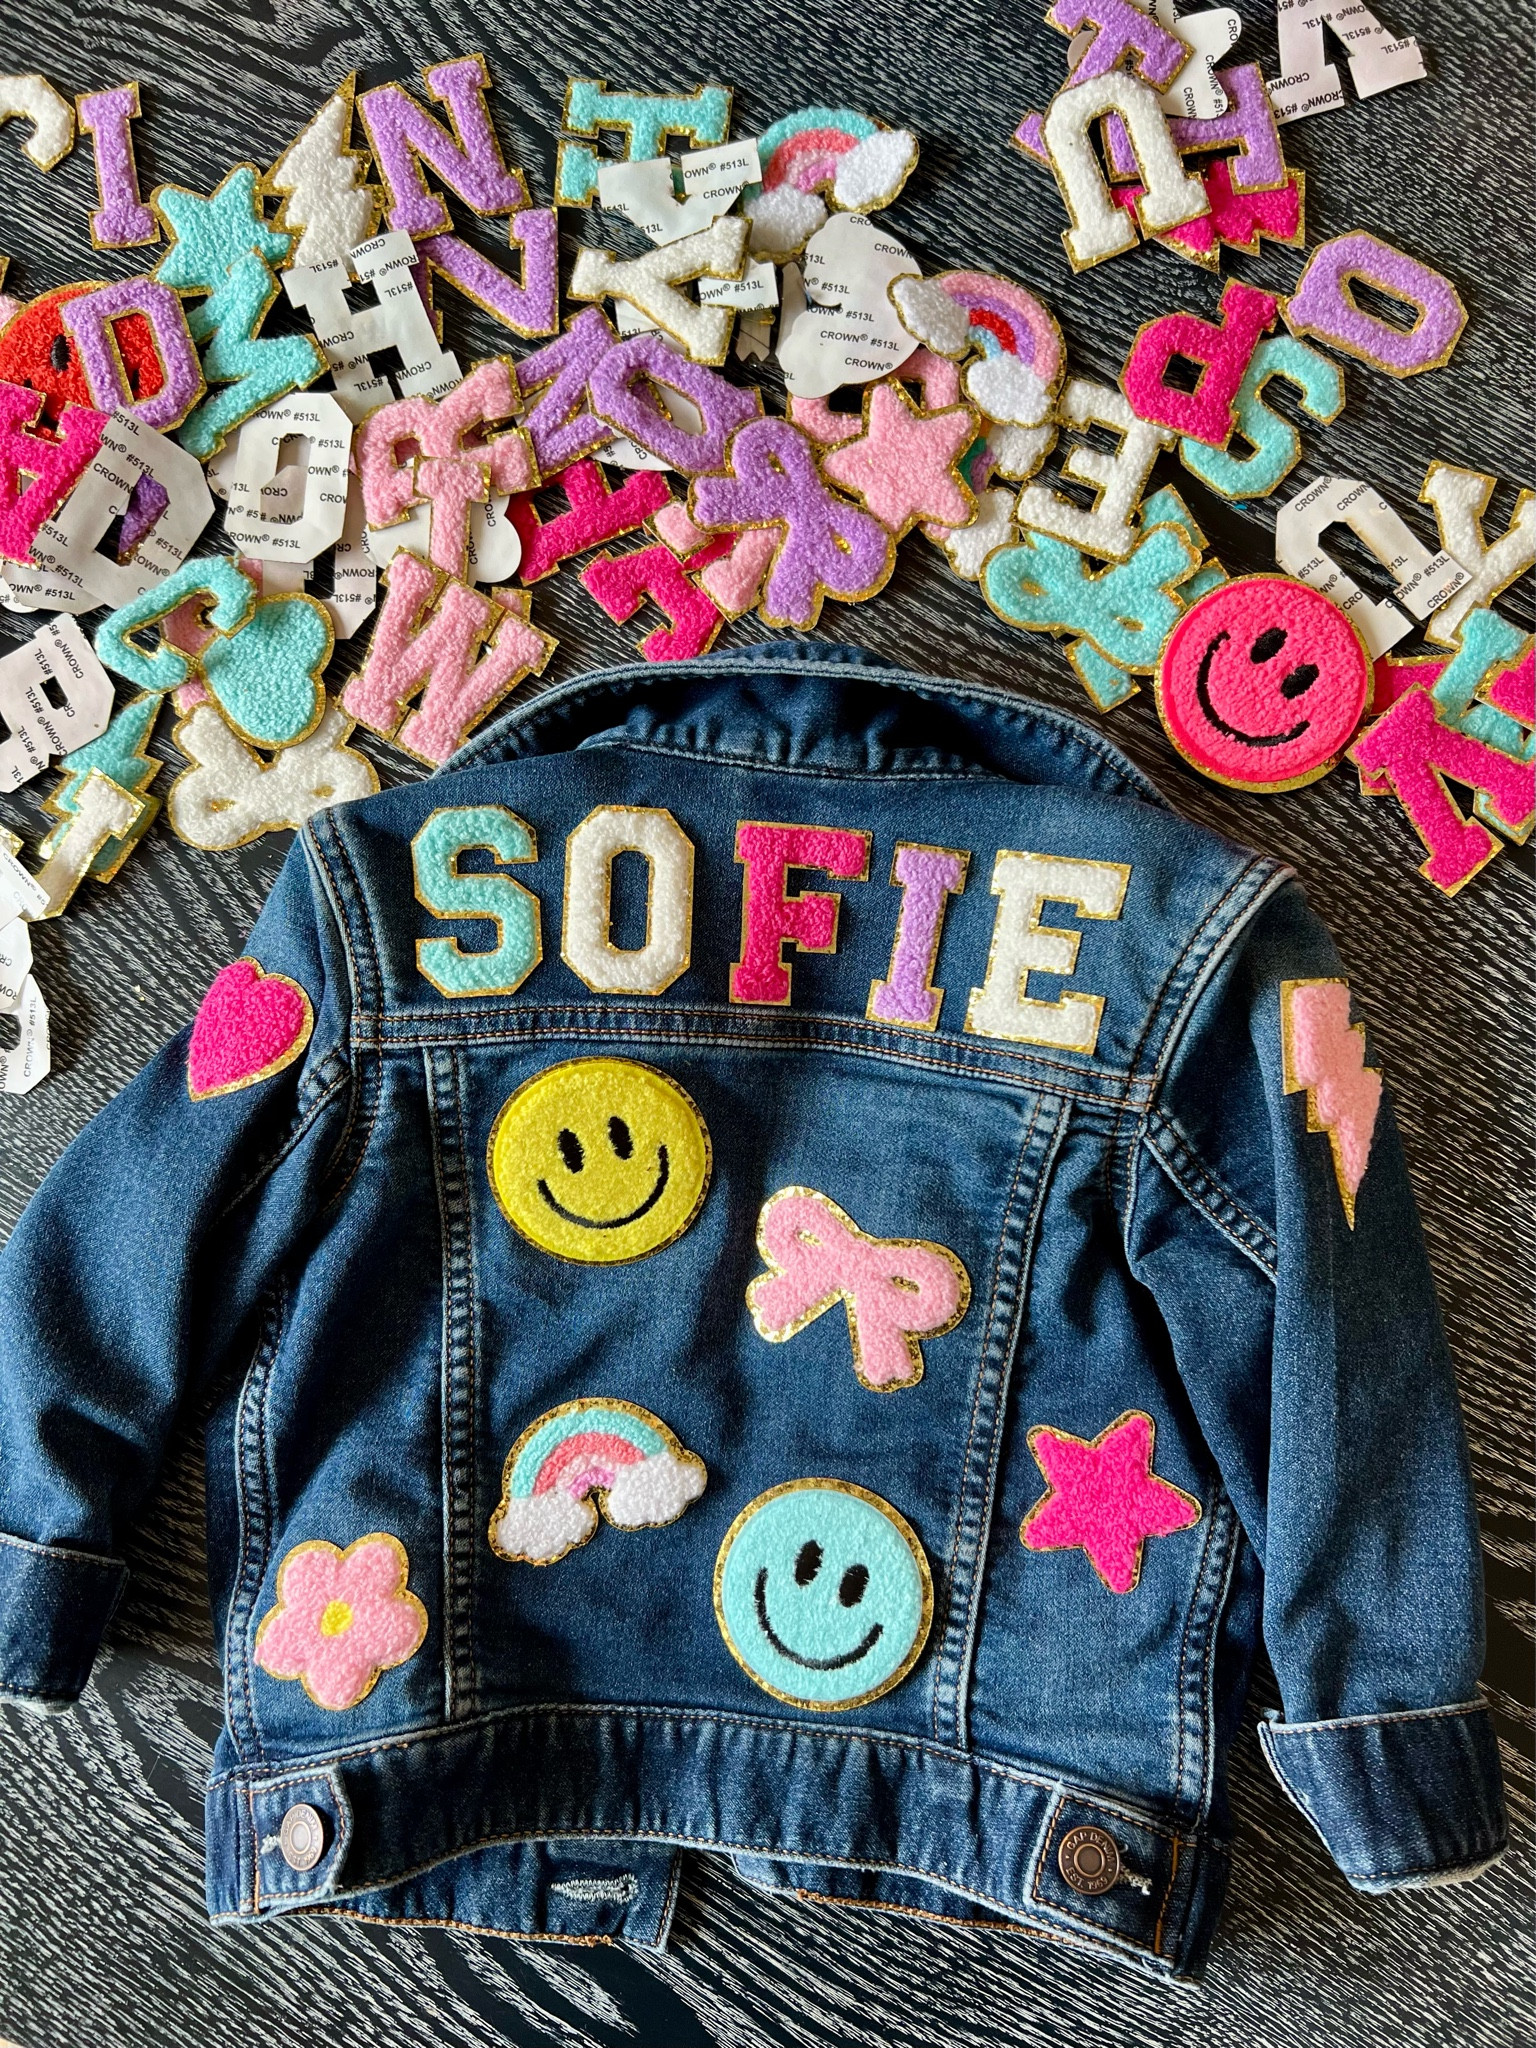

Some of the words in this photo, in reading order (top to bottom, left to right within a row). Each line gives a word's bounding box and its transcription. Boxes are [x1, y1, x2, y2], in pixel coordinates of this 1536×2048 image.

[1342, 26, 1371, 40] #513L
[1381, 40, 1410, 54] #513L
[1269, 72, 1310, 95] CROWN
[75, 82, 161, 250] I
[720, 158, 749, 172] #513L
[309, 258, 339, 274] #513L
[384, 282, 414, 298] #513L
[734, 282, 764, 293] #513L
[821, 282, 850, 294] #513L
[846, 311, 874, 322] #513L
[820, 330, 868, 344] CROWN®
[870, 338, 900, 351] #513L
[844, 358, 893, 371] CROWN®
[354, 376, 384, 392] #513L
[112, 411, 140, 436] #513L
[294, 414, 320, 422] #513L
[318, 439, 346, 449] #513L
[126, 454, 154, 478] #513L
[155, 538, 182, 560] #513L
[272, 538, 301, 548] #513L
[1298, 557, 1324, 580] #513L
[1424, 555, 1450, 578] #513L
[54, 564, 84, 588] #513L
[45, 588, 76, 601] #513L
[34, 648, 53, 676] #513L
[54, 640, 84, 679] CROWN®
[25, 686, 44, 714] #513L
[18, 725, 36, 752] #513L
[411, 804, 1131, 1055] SOFIE
[1066, 1832, 1086, 1850] GAP
[1090, 1832, 1115, 1861] DENIM
[1088, 1876, 1108, 1890] 1969
